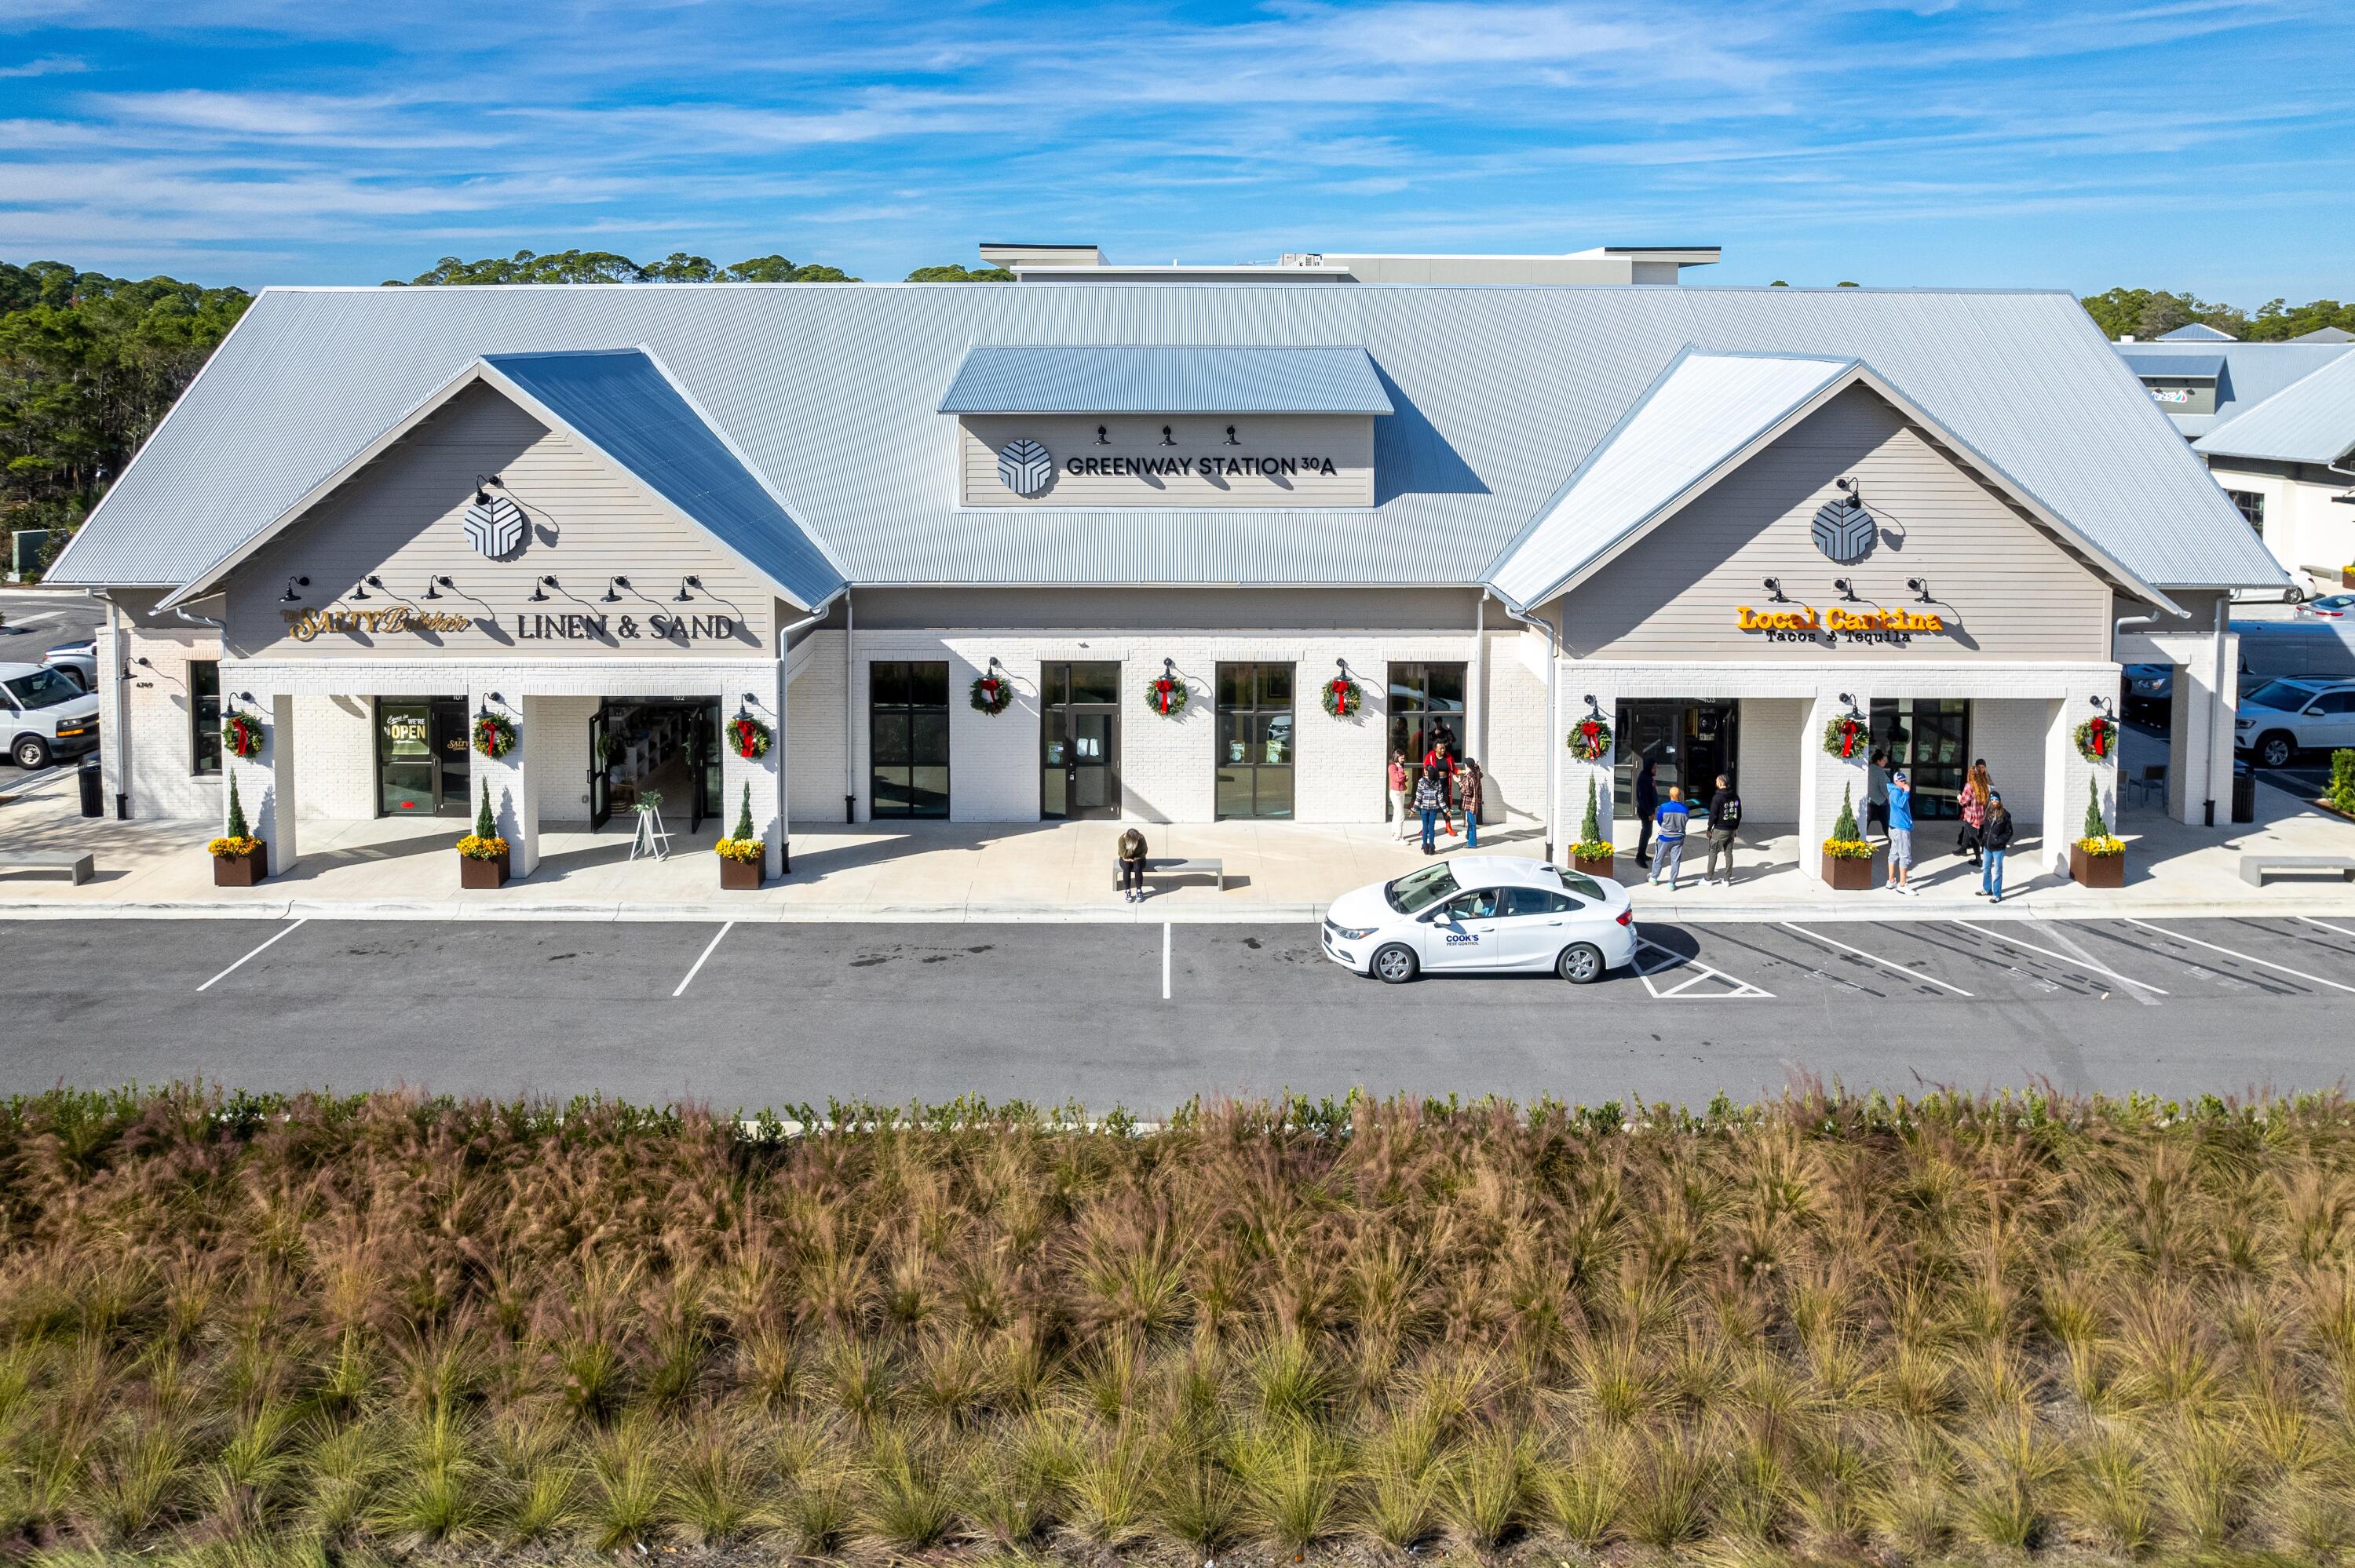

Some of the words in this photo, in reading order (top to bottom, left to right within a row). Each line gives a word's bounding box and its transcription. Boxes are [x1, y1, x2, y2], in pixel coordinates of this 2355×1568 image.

[1066, 457, 1192, 476] GREENWAY
[1199, 457, 1295, 475] STATION
[290, 607, 382, 640] SALTY
[517, 614, 608, 639] LINEN
[617, 614, 641, 639] &
[648, 614, 732, 639] SAND
[1736, 606, 1820, 629] Local
[1826, 607, 1943, 630] Cantina
[1766, 630, 1816, 642] Tacos
[1827, 631, 1837, 642] &
[1846, 630, 1911, 645] Tequila
[391, 725, 425, 738] OPEN
